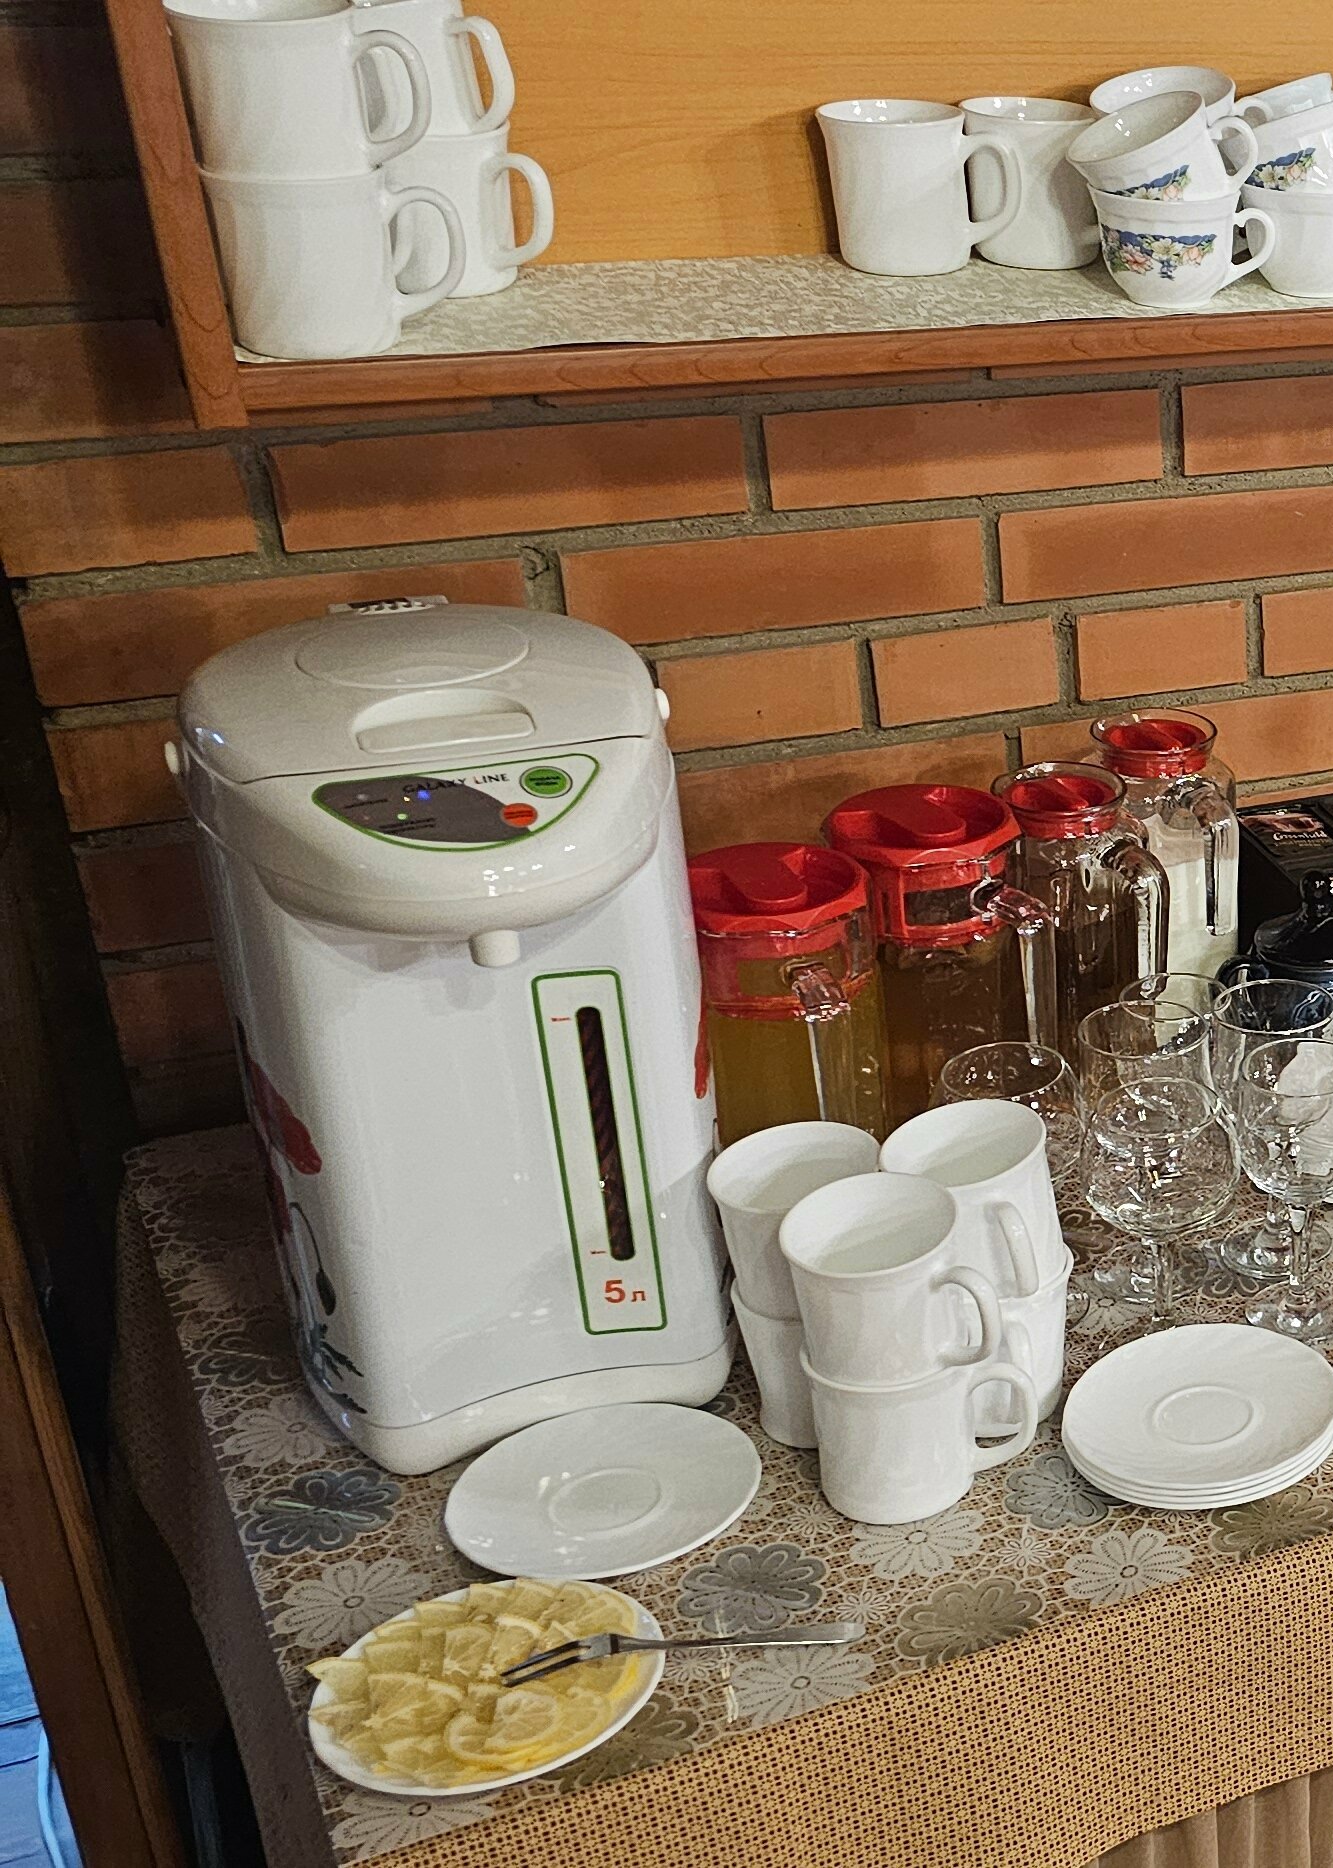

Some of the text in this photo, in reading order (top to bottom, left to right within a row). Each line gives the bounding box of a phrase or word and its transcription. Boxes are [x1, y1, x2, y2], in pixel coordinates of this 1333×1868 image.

[402, 773, 510, 793] GALAXY LINE
[604, 1279, 626, 1304] 5
